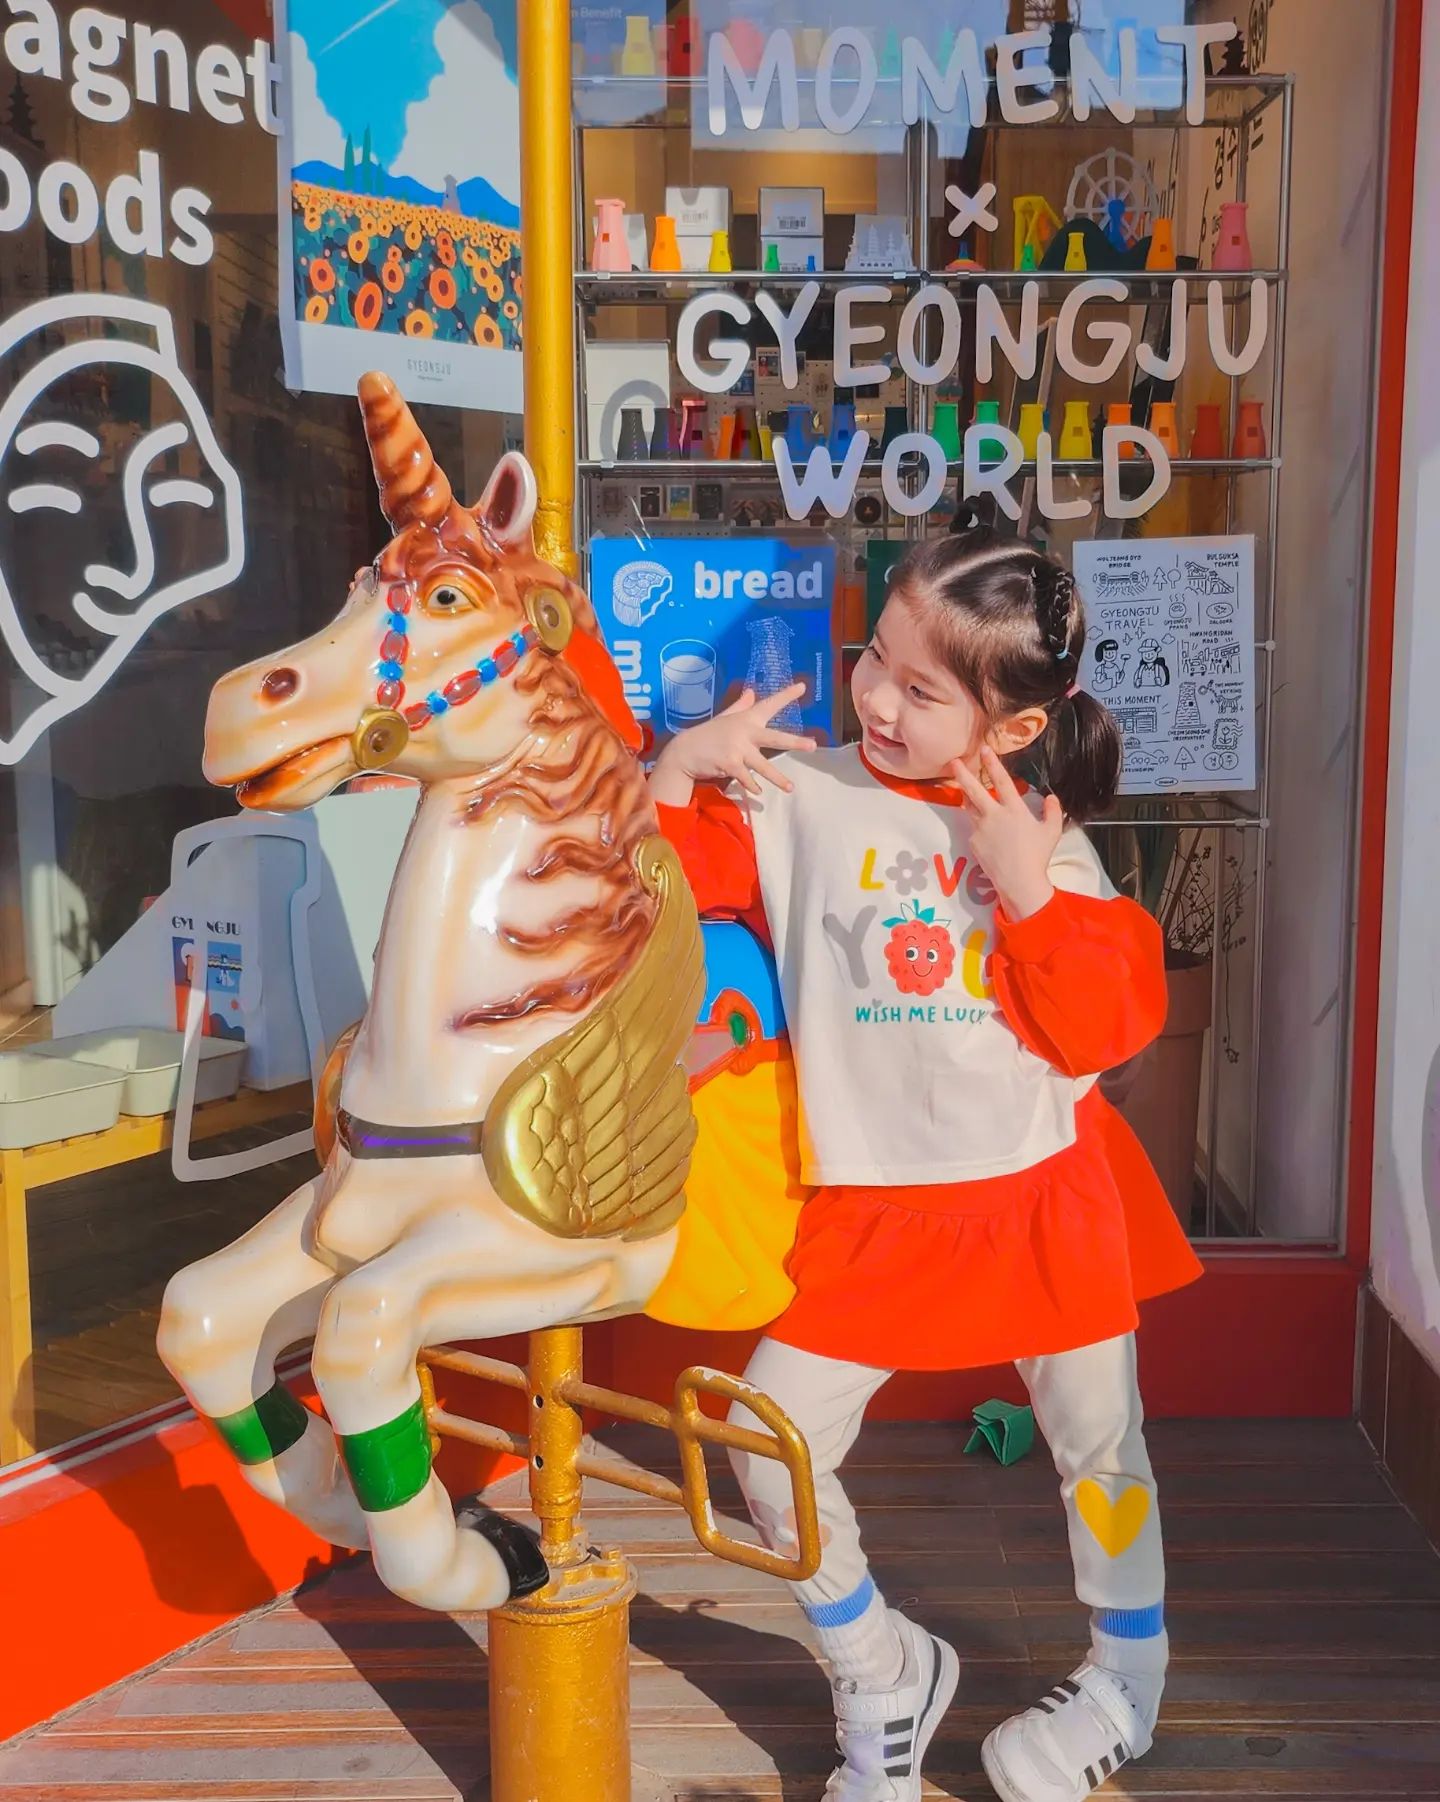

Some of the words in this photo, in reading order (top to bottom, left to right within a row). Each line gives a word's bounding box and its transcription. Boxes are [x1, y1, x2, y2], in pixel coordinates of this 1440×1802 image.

[4, 0, 285, 137] agnet
[707, 22, 1237, 136] MOMENT
[676, 279, 1268, 393] GYEONGJU
[772, 423, 1171, 521] WORLD
[694, 561, 822, 599] bread
[1100, 606, 1160, 619] GYEONGJU
[1105, 618, 1154, 631] TRAVEL
[1102, 696, 1122, 706] THIS
[1124, 694, 1162, 705] MOMENT
[172, 915, 242, 936] GYENGJU
[908, 1006, 936, 1023] ME
